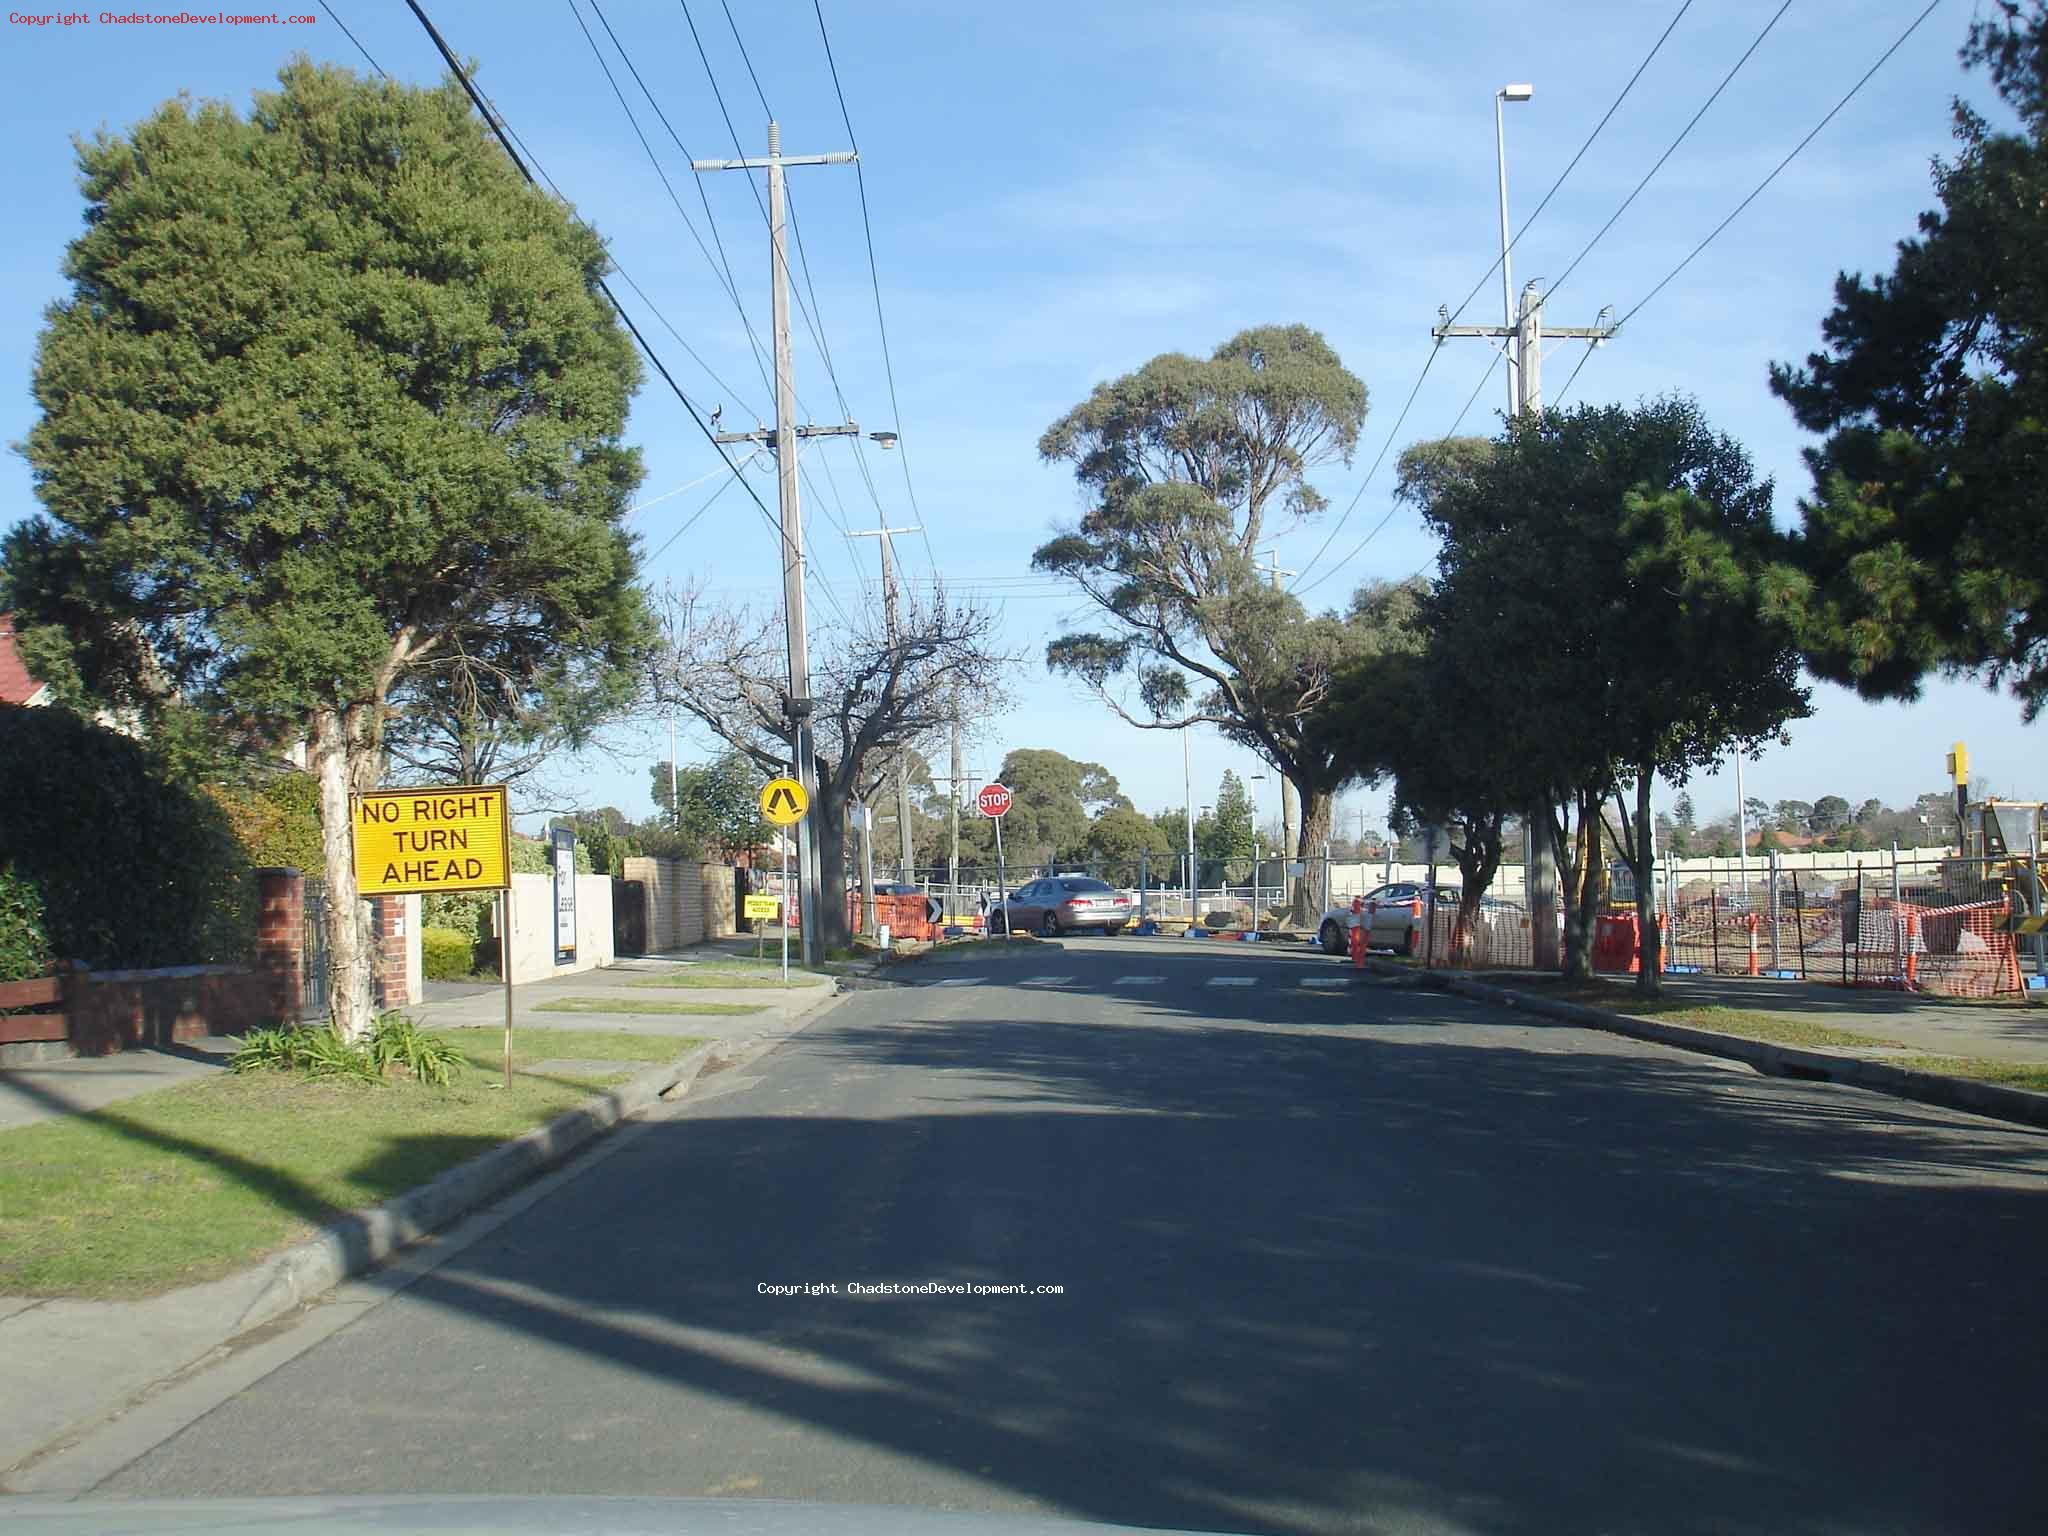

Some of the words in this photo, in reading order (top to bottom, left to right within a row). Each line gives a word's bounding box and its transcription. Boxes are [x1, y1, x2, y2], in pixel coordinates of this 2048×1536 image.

[362, 802, 400, 824] NO
[413, 797, 494, 821] RIGHT
[980, 793, 1009, 808] STOP
[392, 829, 468, 853] TURN
[382, 858, 483, 884] AHEAD
